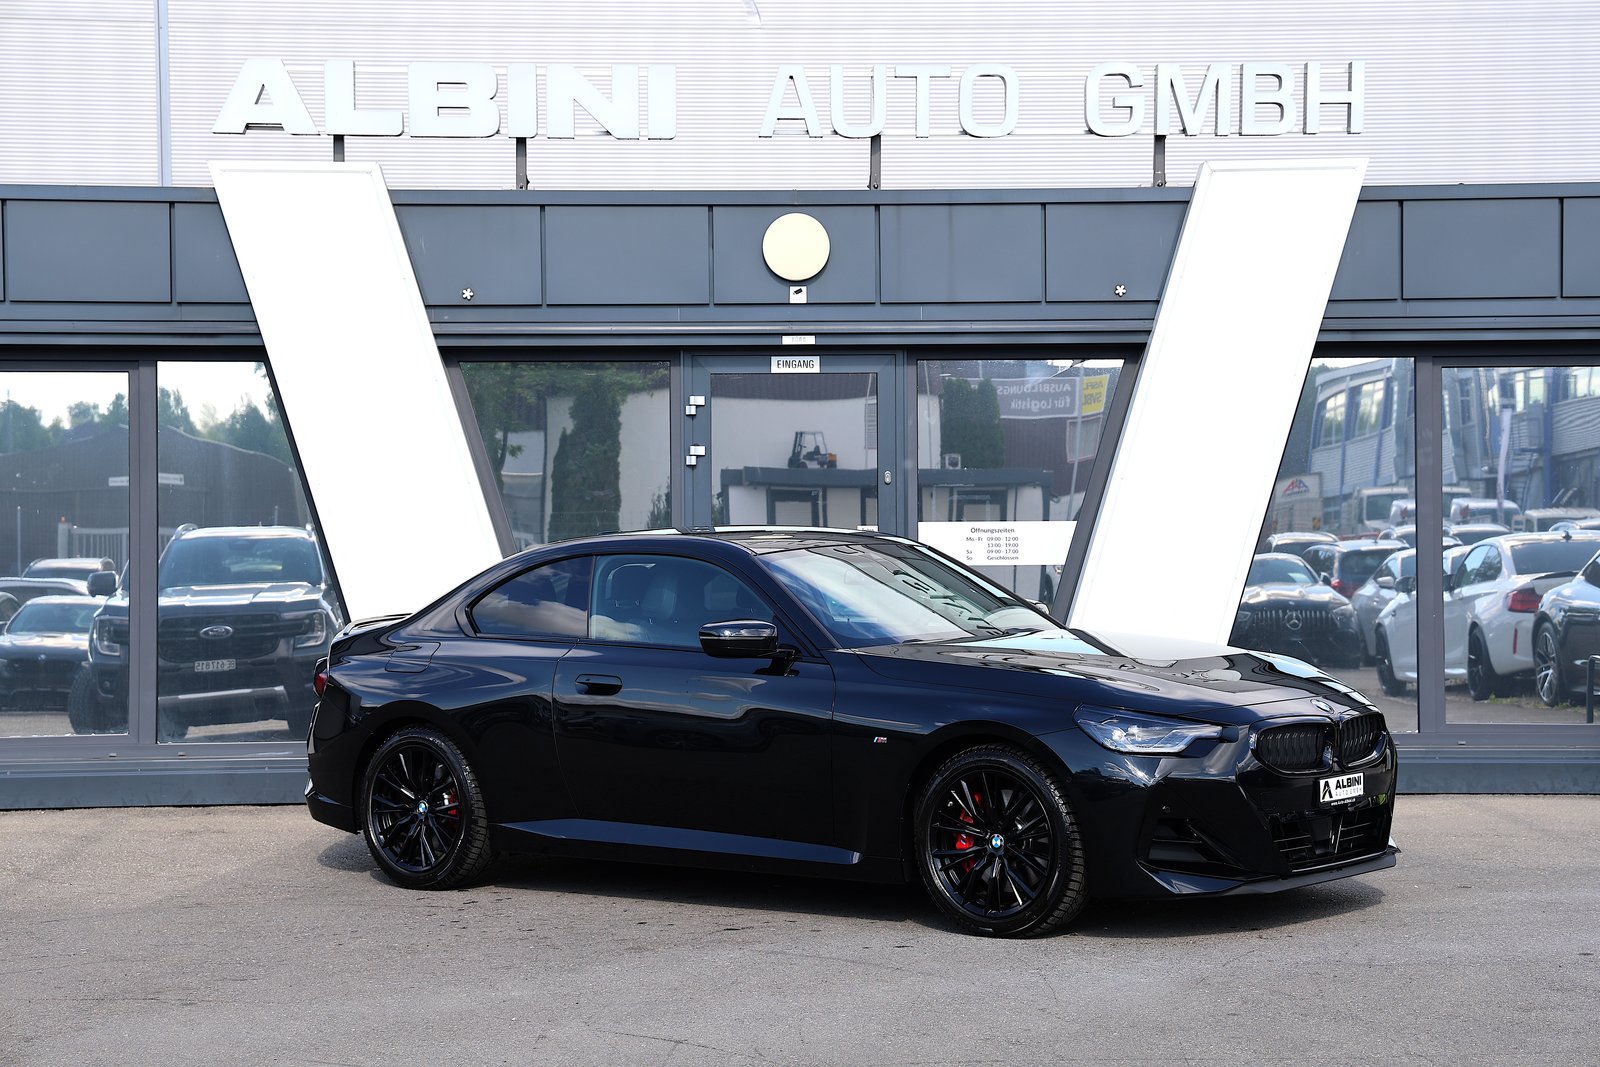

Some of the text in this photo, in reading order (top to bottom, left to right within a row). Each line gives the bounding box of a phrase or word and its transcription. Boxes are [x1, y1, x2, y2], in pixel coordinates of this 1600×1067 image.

[211, 58, 1367, 140] ALBINI AUTO GMBH
[776, 359, 815, 369] EINGANG
[1335, 775, 1362, 790] ALBINI
